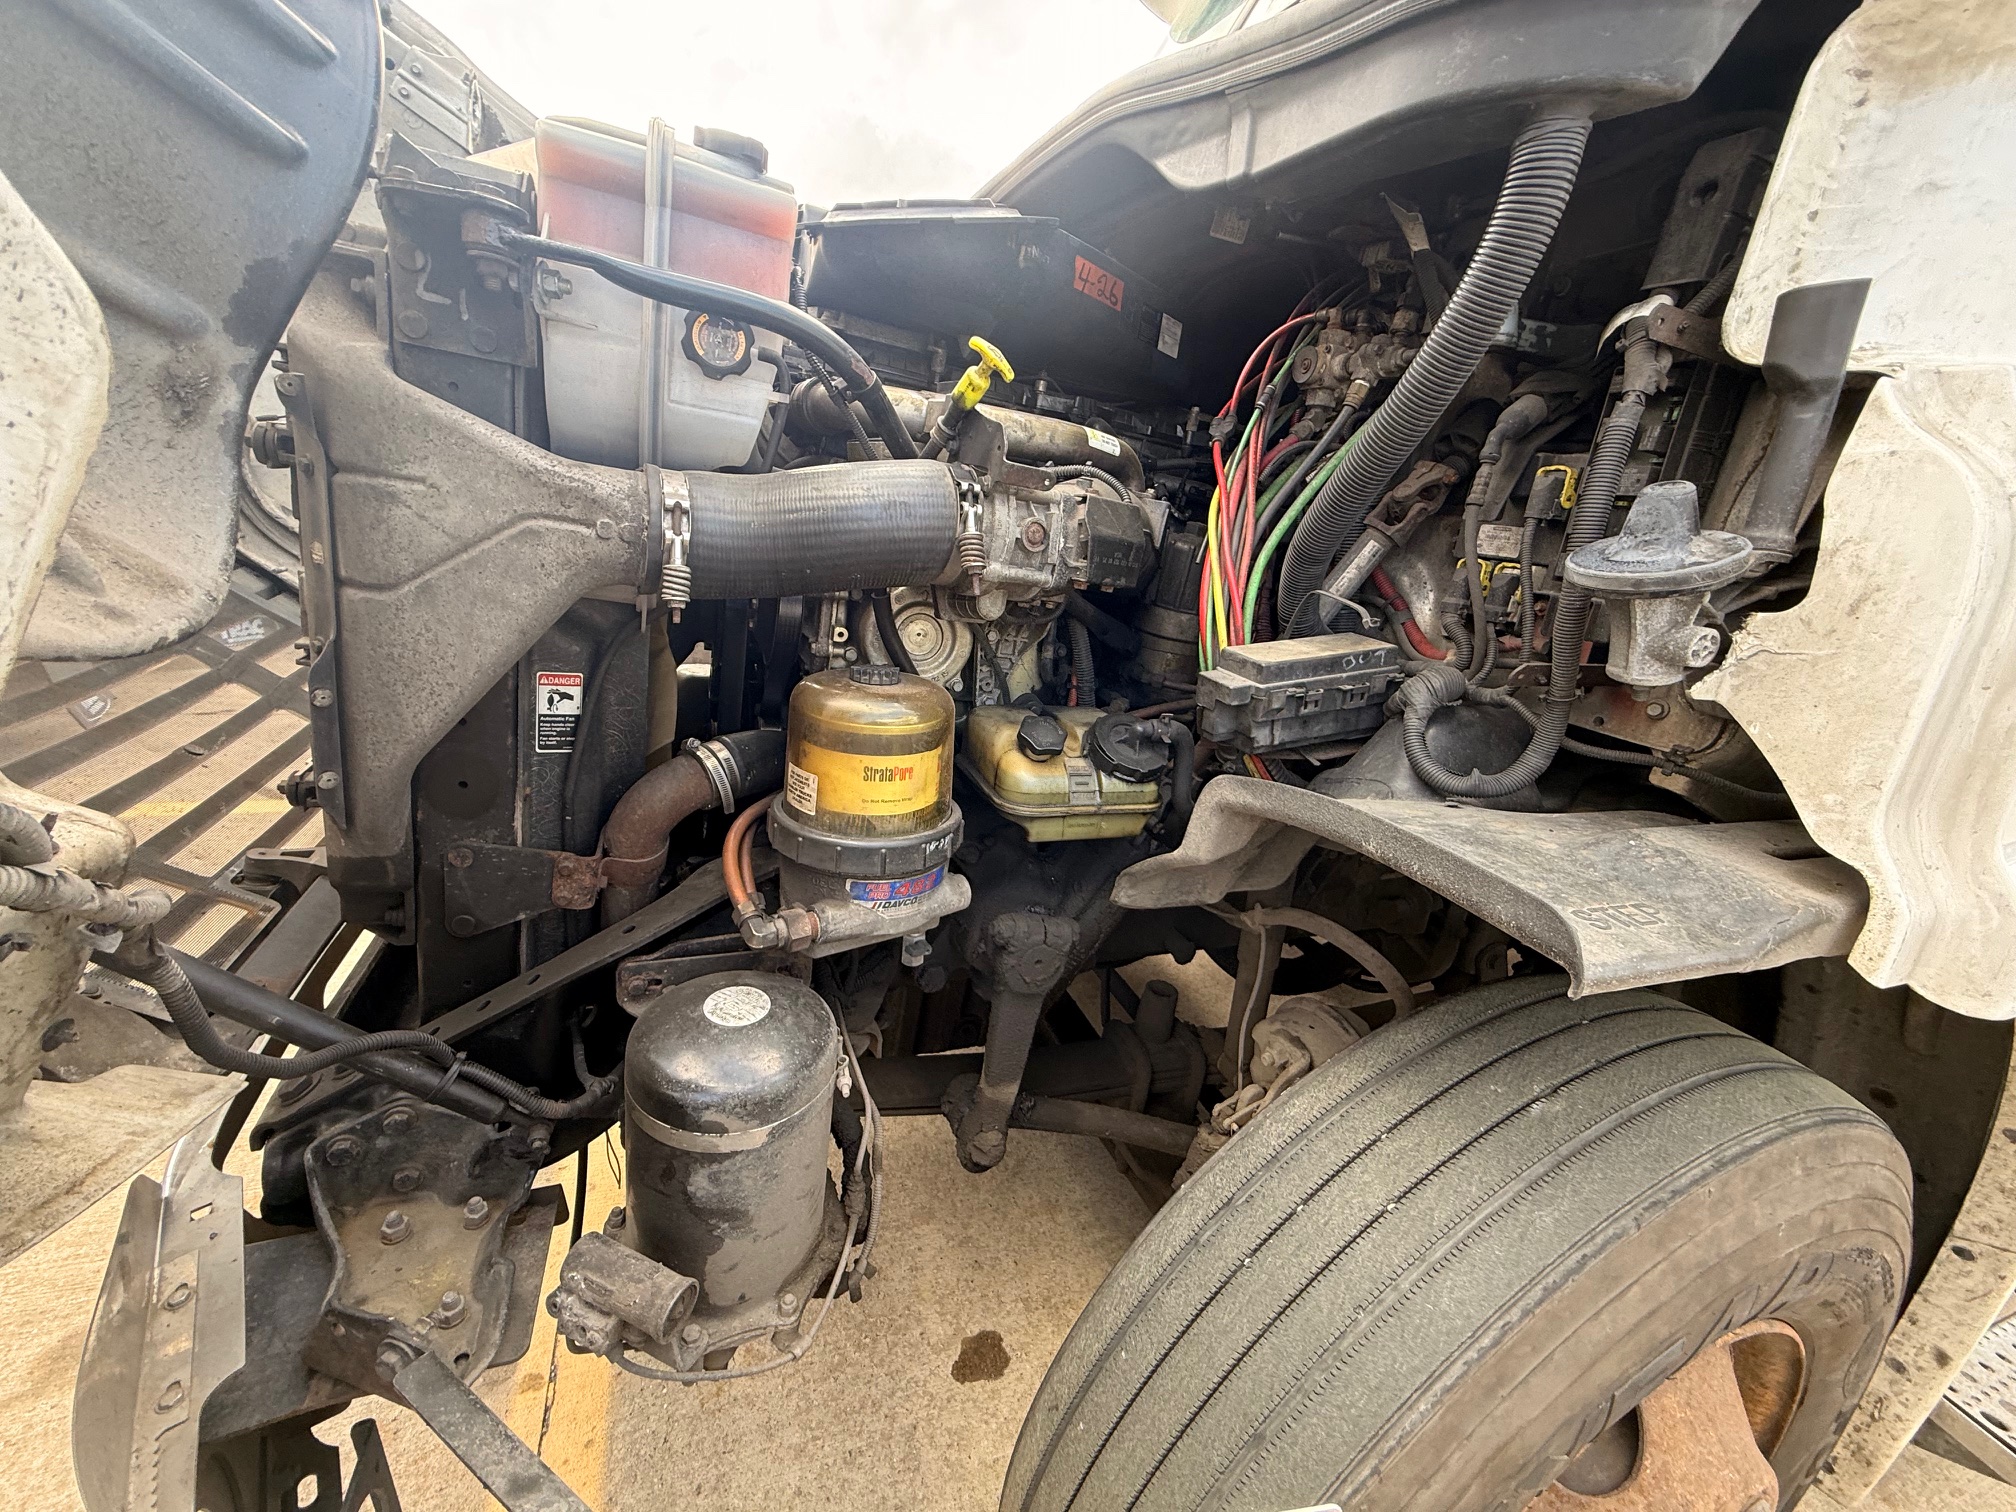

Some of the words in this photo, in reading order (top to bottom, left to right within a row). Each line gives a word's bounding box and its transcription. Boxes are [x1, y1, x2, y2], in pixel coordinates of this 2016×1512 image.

[1079, 262, 1118, 306] 4-26
[548, 677, 581, 685] DANGER
[862, 766, 914, 783] StrataPore
[866, 883, 892, 892] FUEL
[867, 891, 891, 900] PRO
[1570, 902, 1666, 931] STEP
